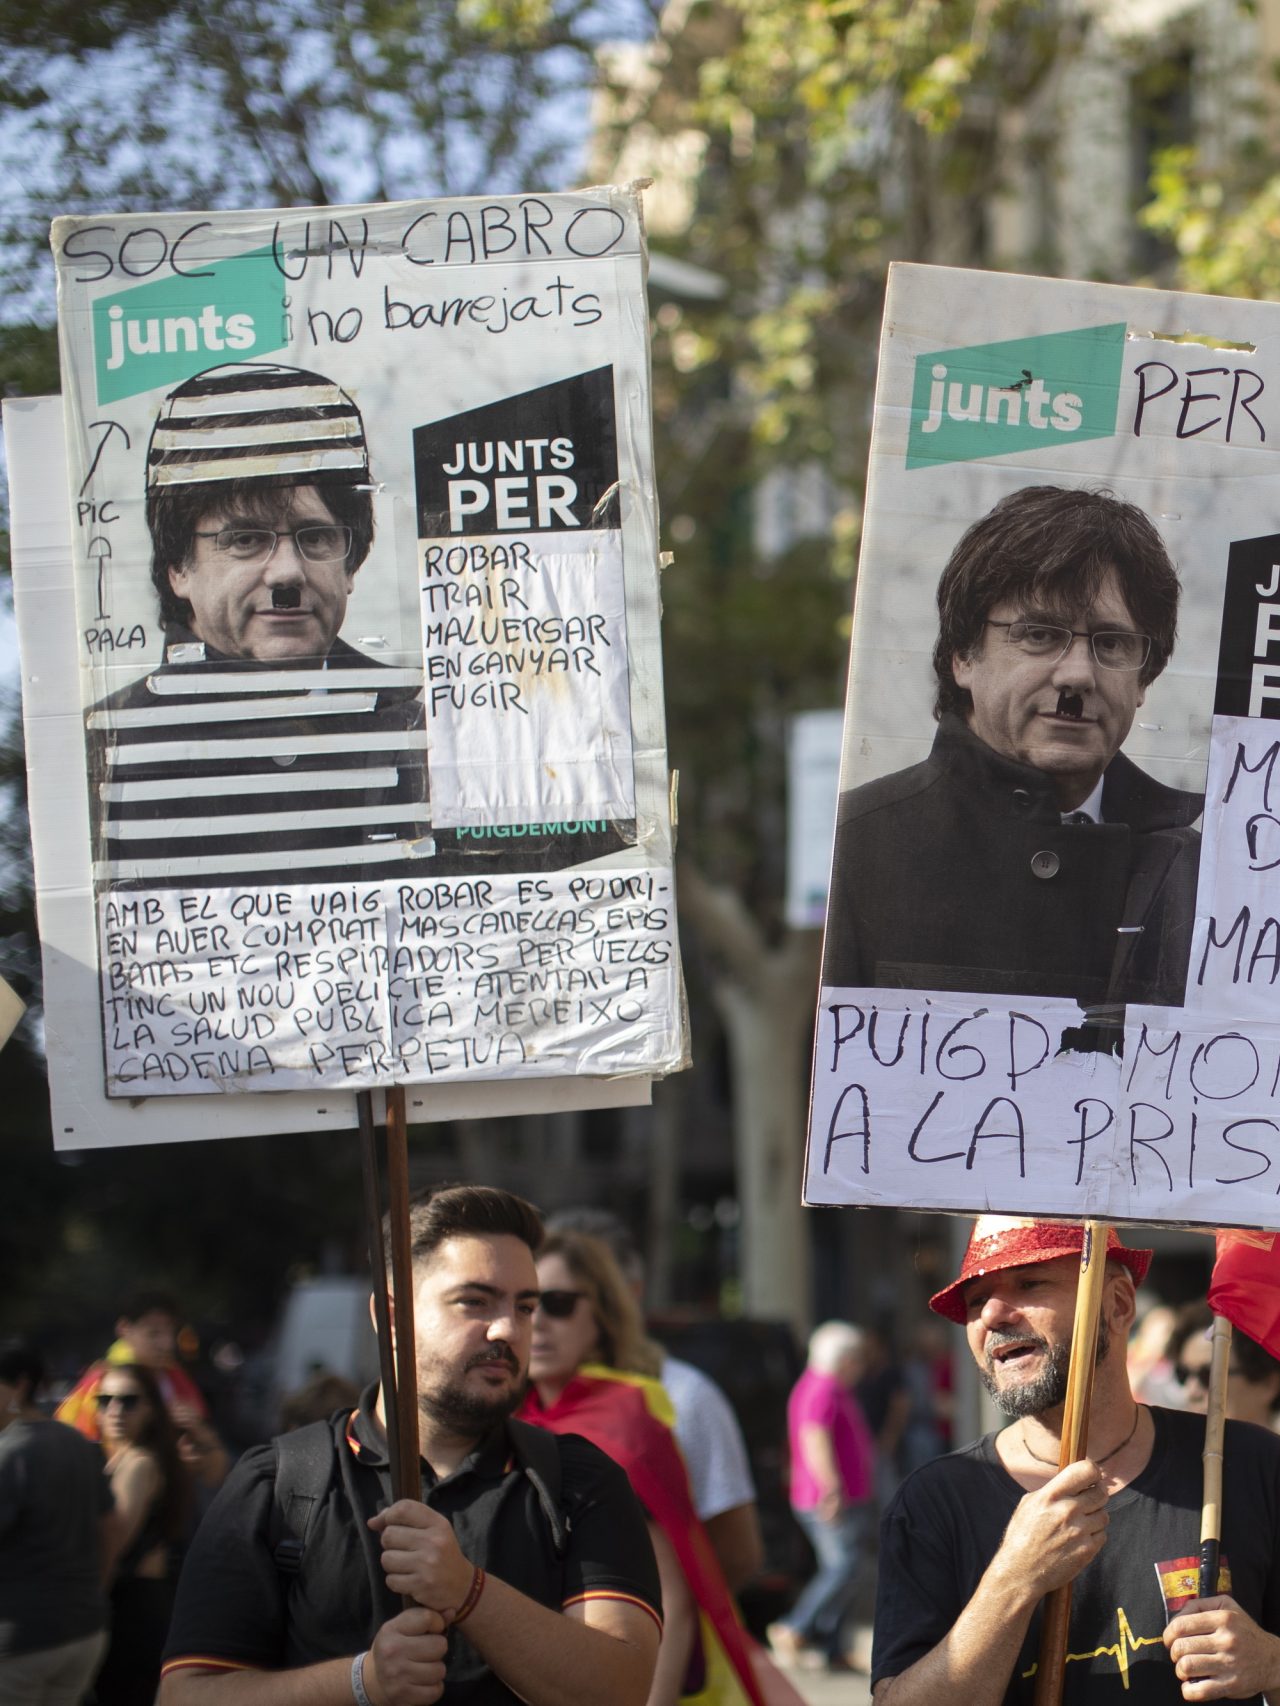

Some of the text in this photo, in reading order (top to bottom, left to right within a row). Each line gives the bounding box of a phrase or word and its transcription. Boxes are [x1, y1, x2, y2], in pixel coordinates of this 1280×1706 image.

[63, 198, 625, 282] SOC UN CABRO
[307, 305, 362, 346] no
[384, 275, 602, 334] barrejats
[106, 305, 256, 371] junts
[922, 364, 1083, 433] junts
[1133, 361, 1266, 442] PER
[442, 437, 574, 476] JUNTS
[450, 475, 581, 532] PER
[424, 542, 538, 577] ROBAR
[422, 576, 529, 613] TRAIR
[85, 624, 146, 654] PALA
[427, 646, 601, 681] ENGANYAR
[431, 680, 529, 718] FUGIR
[456, 820, 608, 840] PUIGDEMONT
[105, 898, 164, 930] AMB
[179, 895, 218, 923] EL
[230, 893, 292, 926] QUE
[398, 880, 493, 914] ROBAR
[518, 880, 553, 906] ES
[107, 930, 137, 958] EN
[242, 917, 380, 948] COMPRAT
[109, 960, 193, 991] BATAS
[208, 954, 260, 978] ETC
[276, 942, 499, 982] RESPIRADORS
[517, 938, 575, 968] PER
[106, 991, 175, 1024] TINC
[189, 986, 225, 1016] UN
[237, 982, 295, 1010] NOU
[474, 967, 610, 998] ATENTAR
[625, 966, 648, 991] A
[113, 1024, 156, 1050] LA
[171, 1013, 276, 1046] SALUD
[293, 1001, 453, 1037] PUBLICA
[118, 1045, 276, 1083] CADENA
[823, 1083, 871, 1173] A
[907, 1090, 1026, 1178] LA
